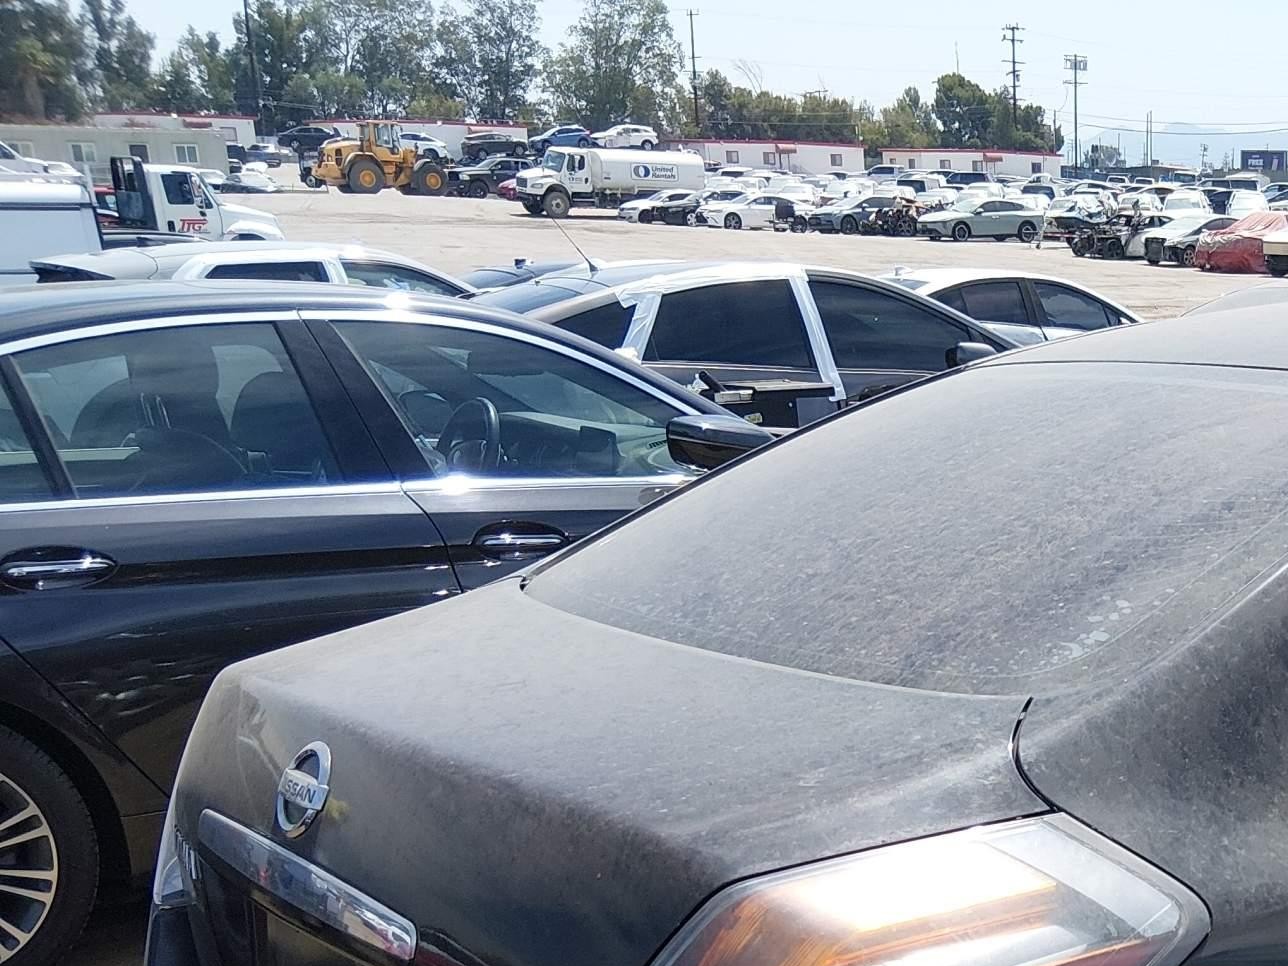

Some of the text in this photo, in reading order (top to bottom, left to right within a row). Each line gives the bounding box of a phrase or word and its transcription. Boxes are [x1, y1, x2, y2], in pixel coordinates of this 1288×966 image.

[651, 165, 674, 173] United
[651, 172, 676, 180] Rentals
[280, 773, 317, 804] SSAN
